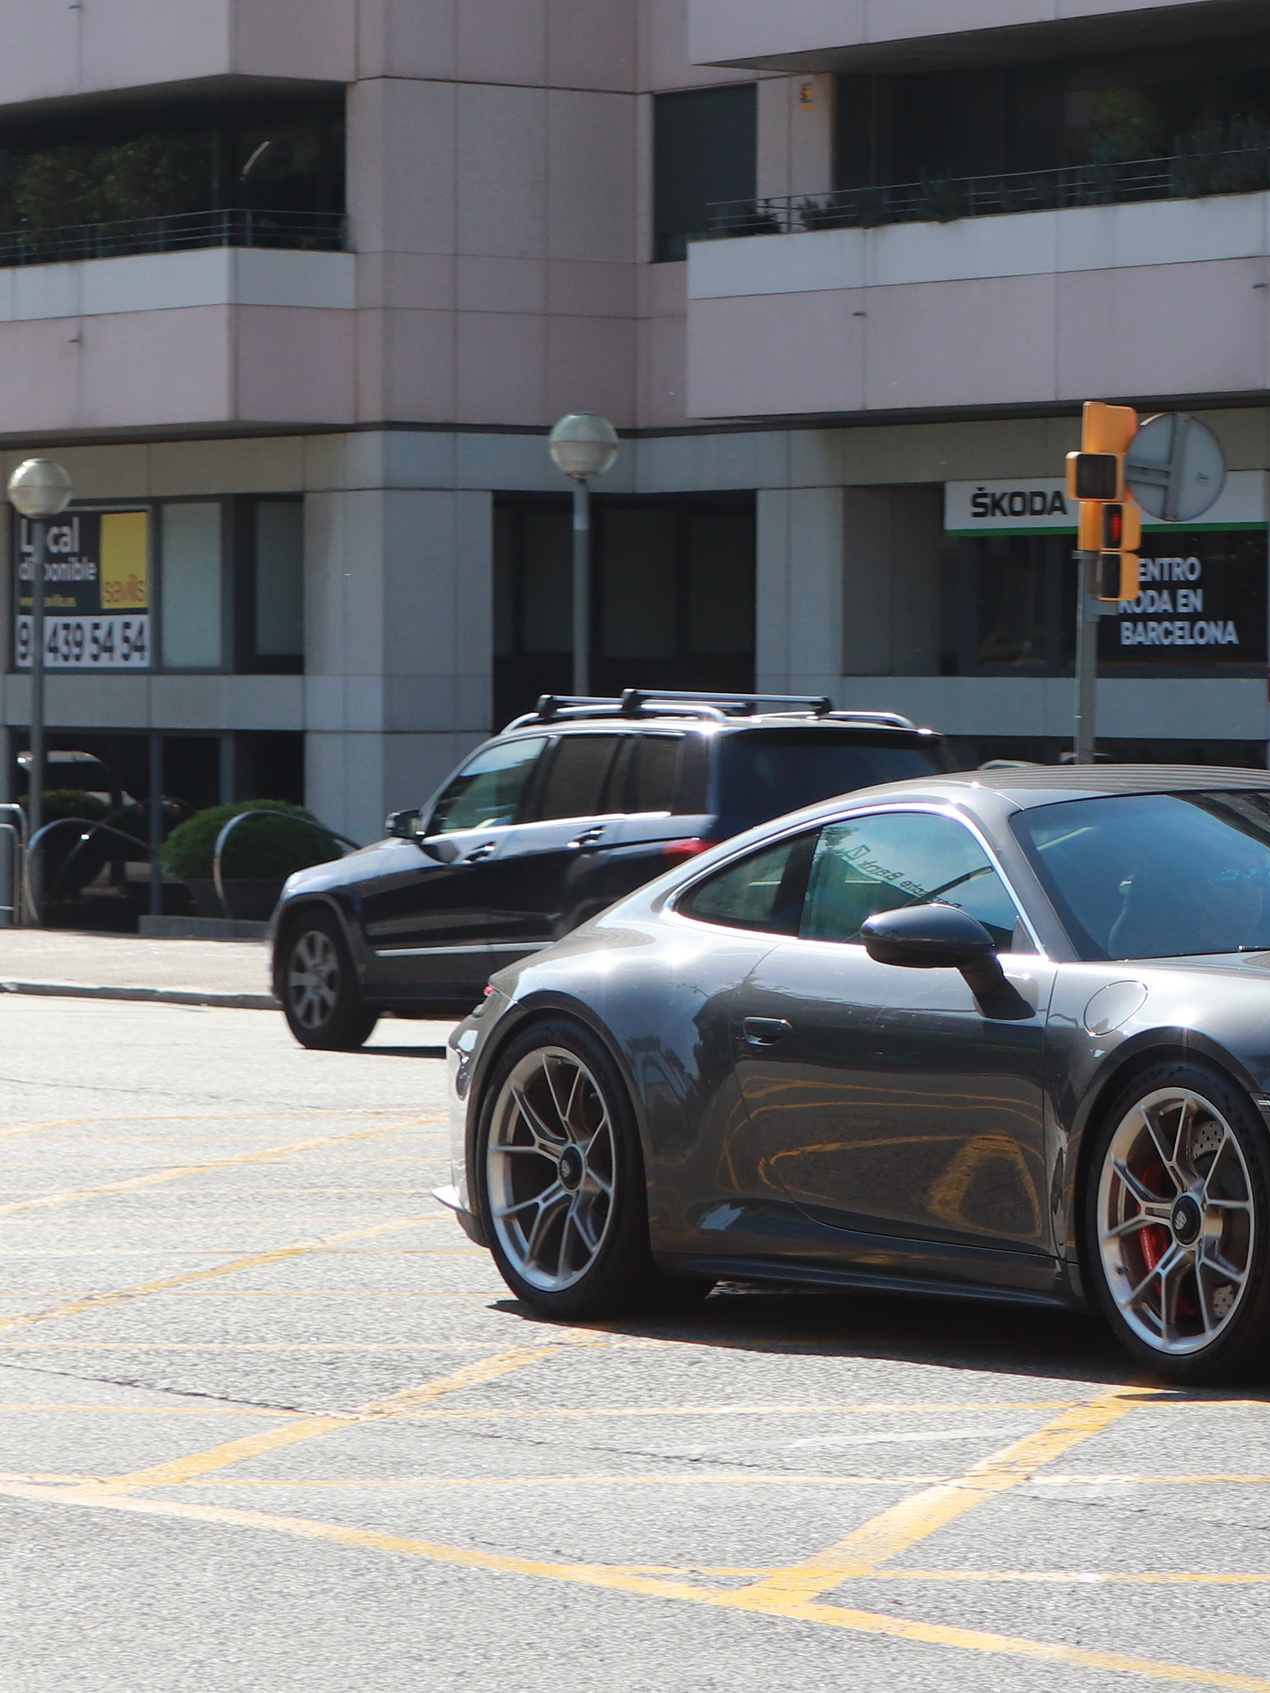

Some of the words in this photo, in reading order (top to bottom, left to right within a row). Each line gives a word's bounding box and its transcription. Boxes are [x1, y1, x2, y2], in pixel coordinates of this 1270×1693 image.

[971, 486, 1068, 518] ŠKODA
[20, 516, 80, 552] Lcal
[18, 556, 97, 581] dionible
[1138, 557, 1201, 581] ENTRO
[1118, 589, 1175, 613] KODA
[1177, 589, 1203, 613] EN
[47, 622, 84, 661] 439
[91, 622, 114, 661] 54
[121, 621, 146, 661] 54
[1120, 621, 1239, 645] BARCELONA
